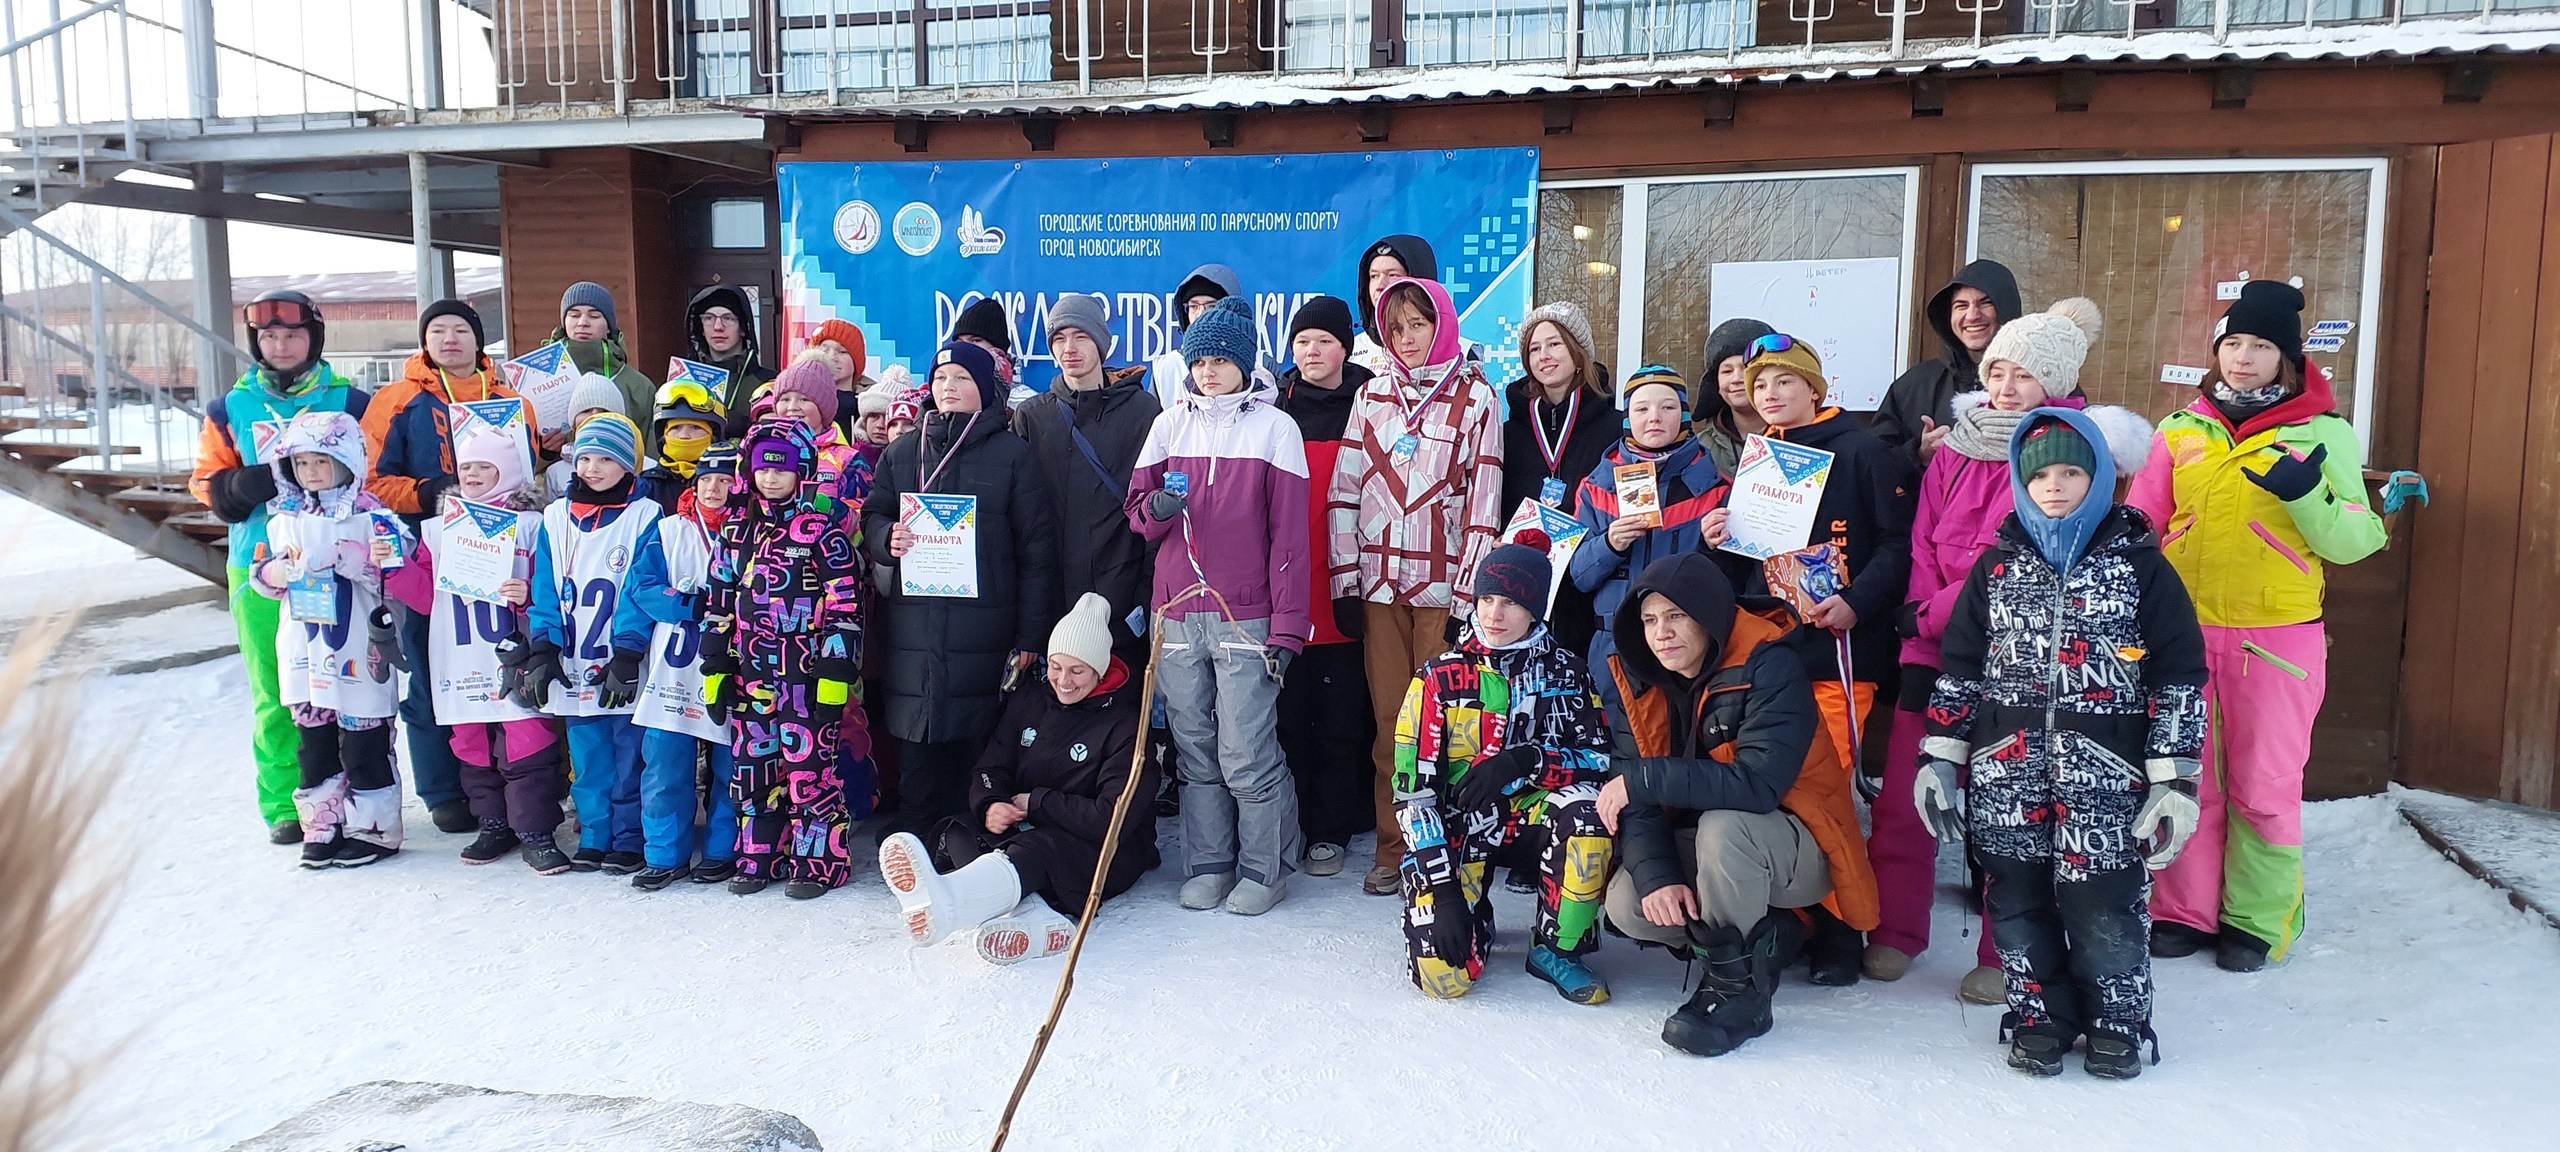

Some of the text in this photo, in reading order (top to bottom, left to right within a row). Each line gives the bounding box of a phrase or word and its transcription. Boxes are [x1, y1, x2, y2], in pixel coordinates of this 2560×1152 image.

[1039, 211, 1340, 233] ГОРОДСКИЕ СОРЕВНОВАНИЯ ПО ПАРУСНОМУ СПОРТУ
[1039, 238, 1161, 258] ГОРОД НОВОСИБИРСК
[531, 374, 571, 395] ГРАМОТА
[1751, 482, 1804, 505] ГРАМОТА
[457, 535, 502, 555] ГРАМОТА
[915, 534, 963, 546] ГРАМОТА
[2059, 693, 2084, 703] NOT
[2085, 690, 2114, 700] MAD
[2071, 807, 2098, 826] not
[2061, 825, 2127, 854] NOT
